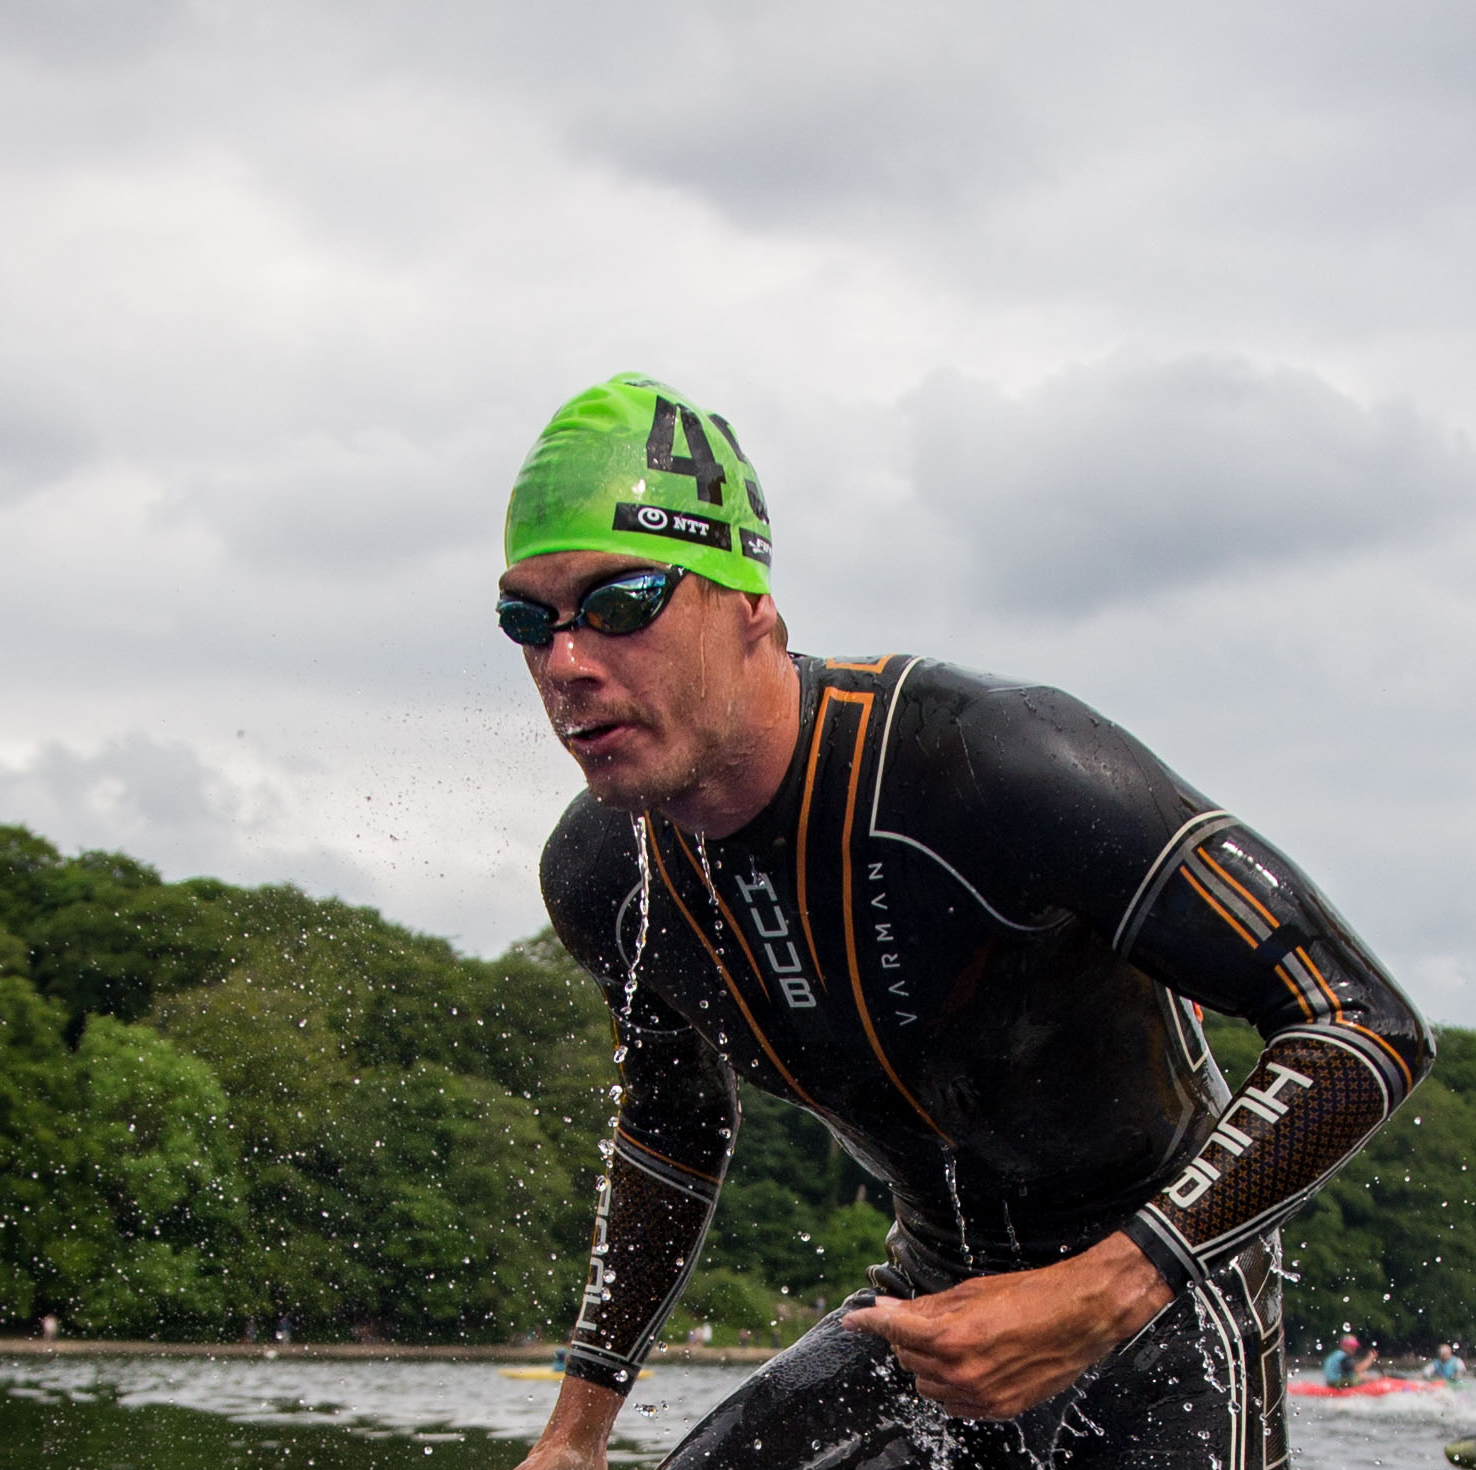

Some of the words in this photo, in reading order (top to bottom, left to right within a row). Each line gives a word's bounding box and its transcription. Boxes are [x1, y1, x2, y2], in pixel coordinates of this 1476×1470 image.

[672, 516, 710, 537] NTT
[734, 872, 817, 1008] HUUB
[868, 862, 918, 1026] VARMAN
